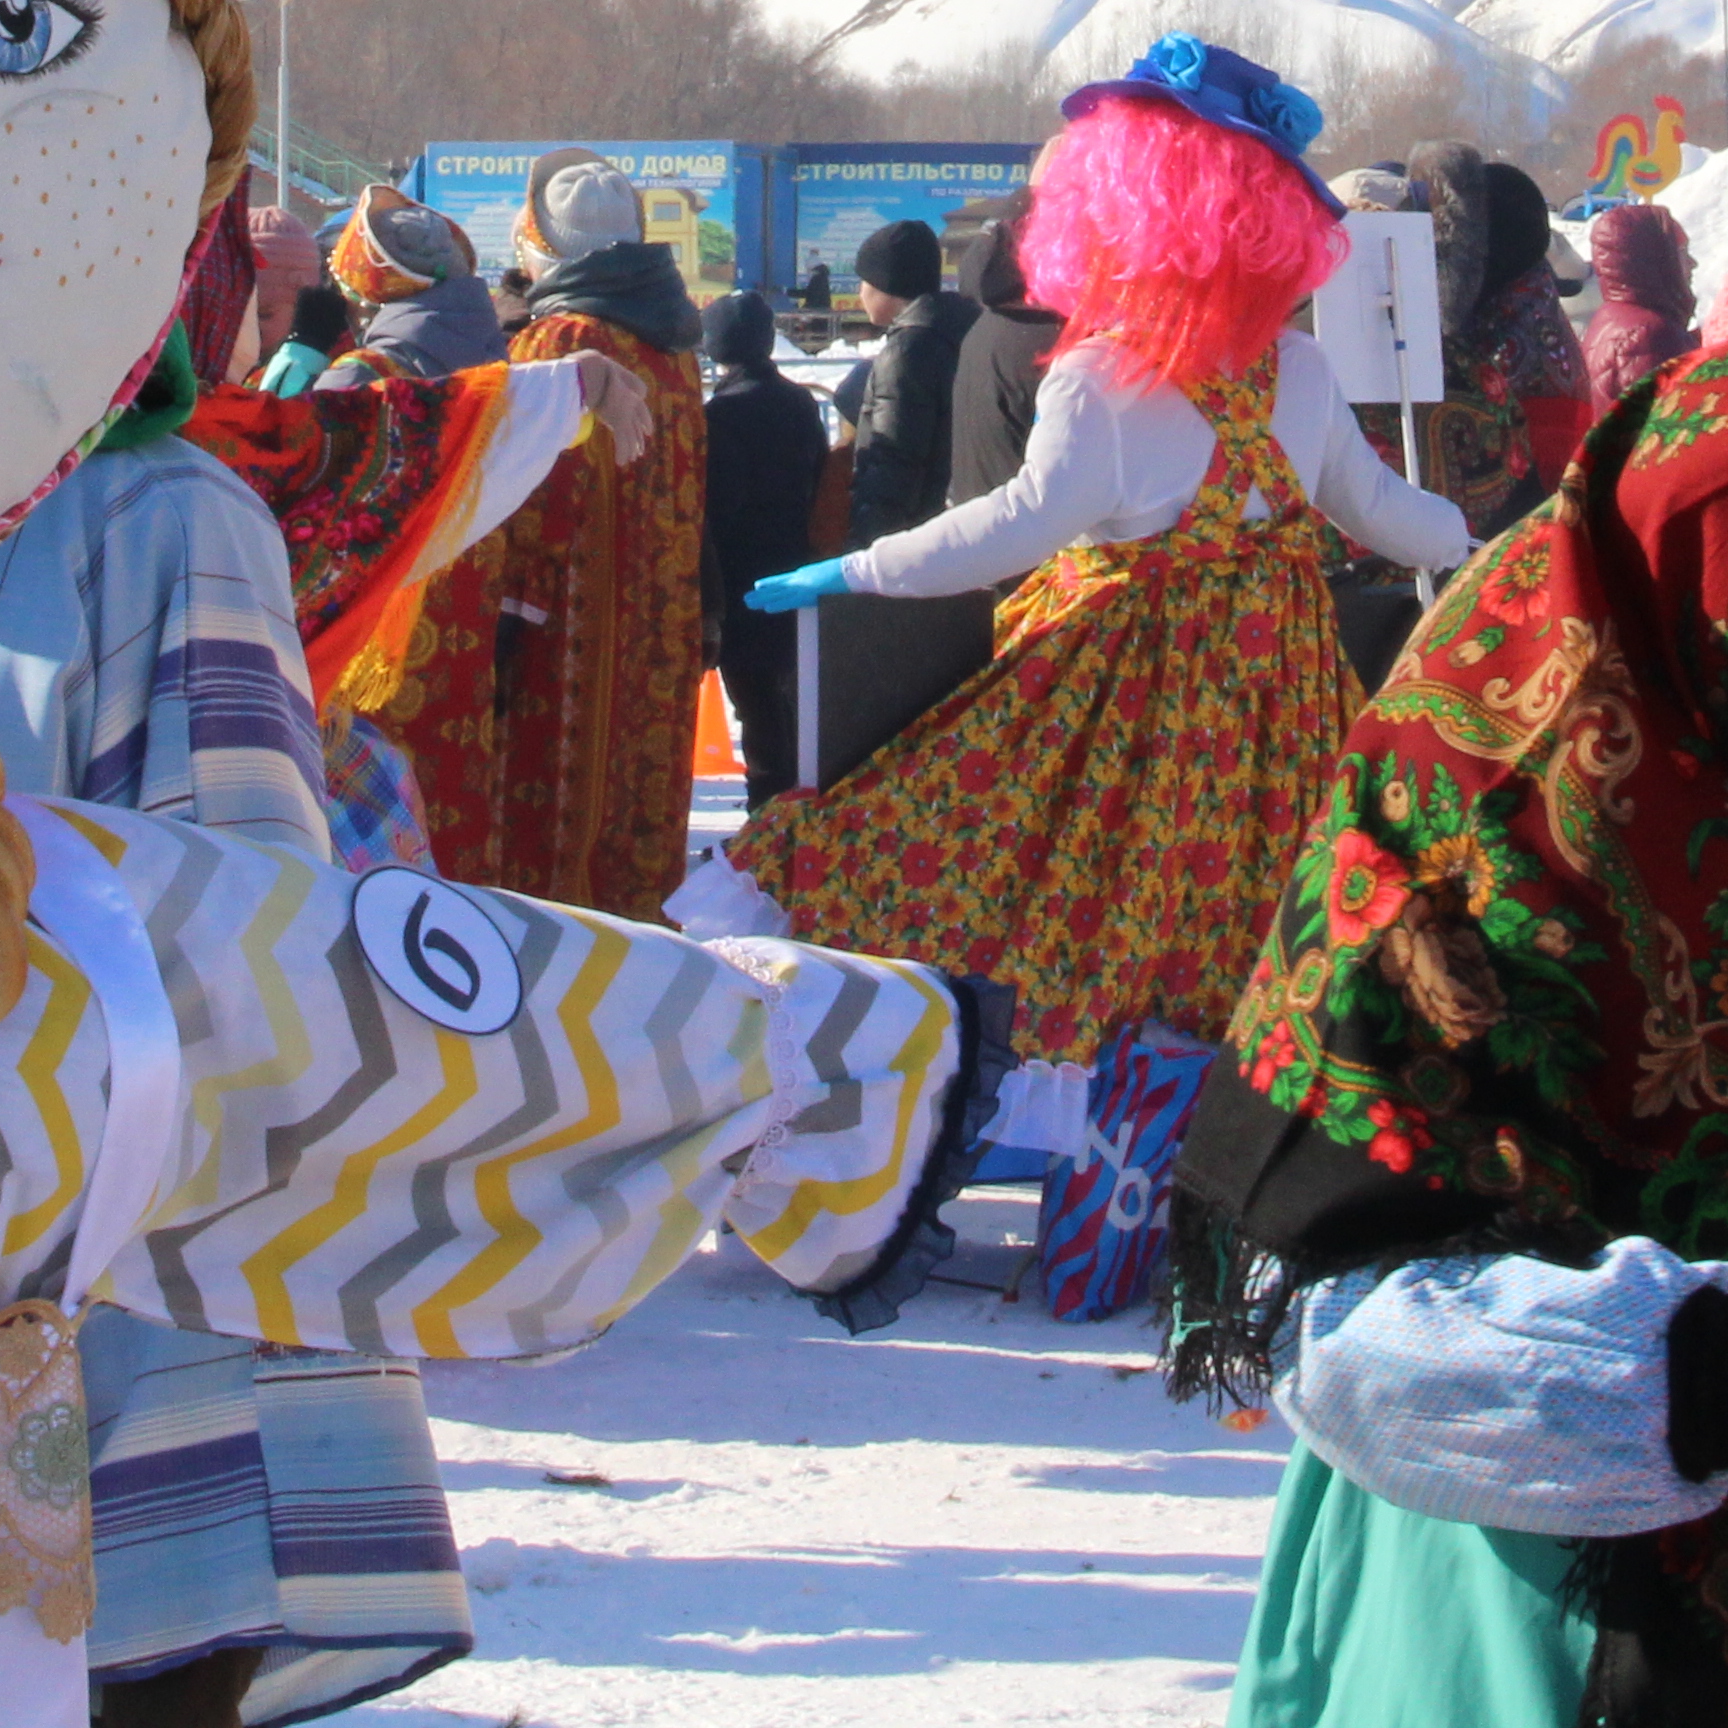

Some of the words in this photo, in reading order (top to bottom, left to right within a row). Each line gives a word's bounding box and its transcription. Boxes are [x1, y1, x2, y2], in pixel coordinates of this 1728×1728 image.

[641, 155, 727, 177] ДОМОВ
[794, 163, 1004, 181] СТРОИТЕЛЬСТВО
[403, 891, 481, 1012] 6
